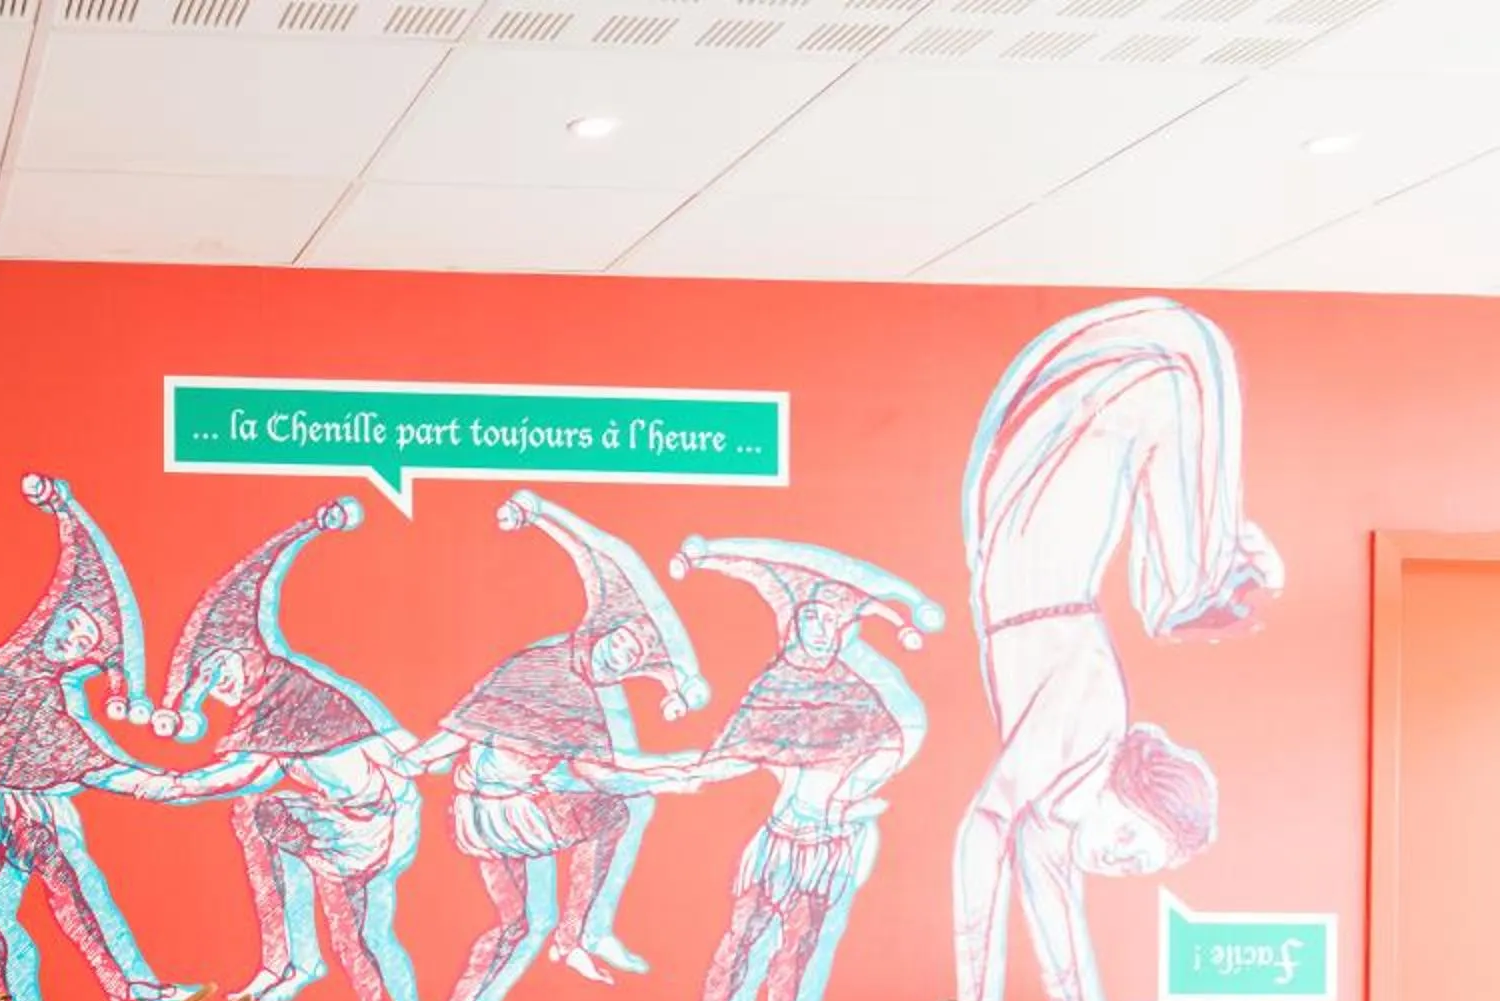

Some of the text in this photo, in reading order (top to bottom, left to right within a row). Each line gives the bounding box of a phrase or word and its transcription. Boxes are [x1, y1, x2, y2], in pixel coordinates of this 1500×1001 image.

[231, 409, 258, 441] la
[267, 411, 386, 446] Chenille
[396, 418, 460, 451] part
[469, 416, 593, 452] toujours
[601, 420, 620, 449] à
[629, 417, 726, 455] l'heure
[1211, 938, 1304, 984] Facile
